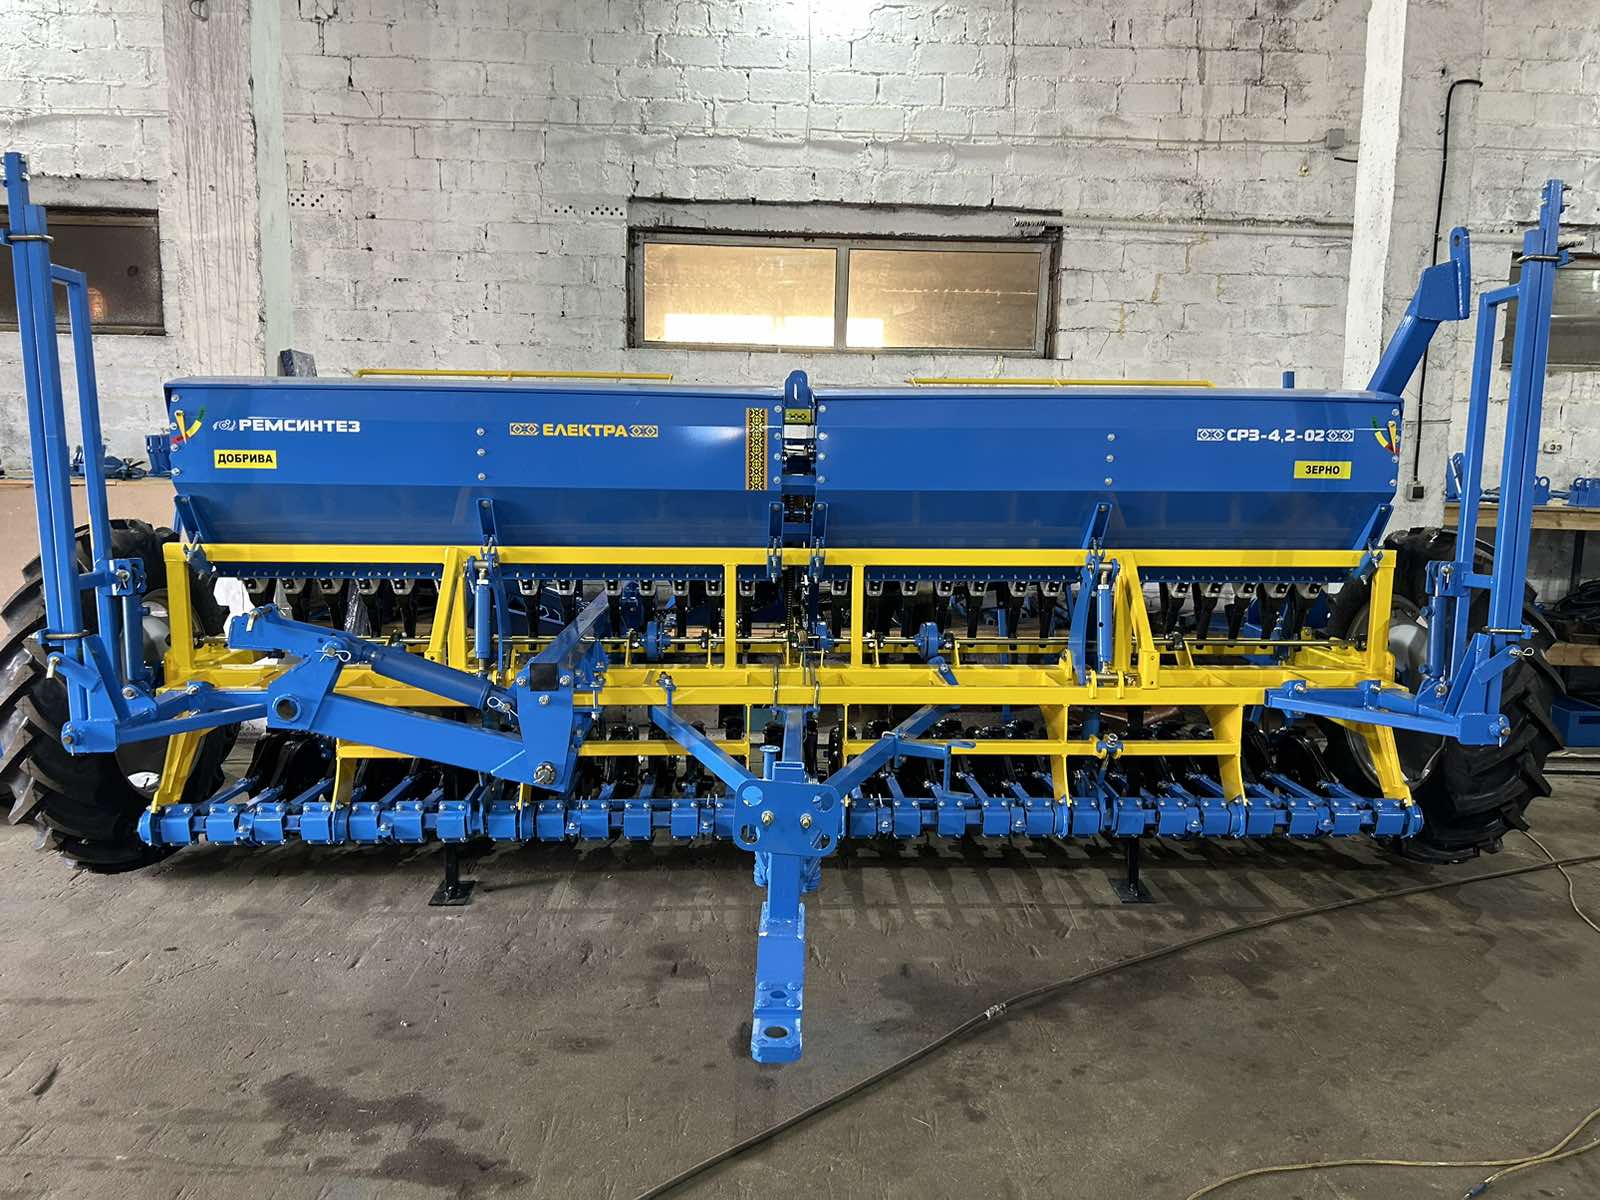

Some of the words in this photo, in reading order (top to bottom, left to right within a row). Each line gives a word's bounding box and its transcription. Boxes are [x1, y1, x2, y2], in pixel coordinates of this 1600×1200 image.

[239, 419, 360, 432] РЕМСИНТЕЗ
[543, 424, 628, 437] ЕЛЕКТРА
[218, 454, 273, 464] ДОБРИВА
[1305, 465, 1340, 474] ЗЕРНО
